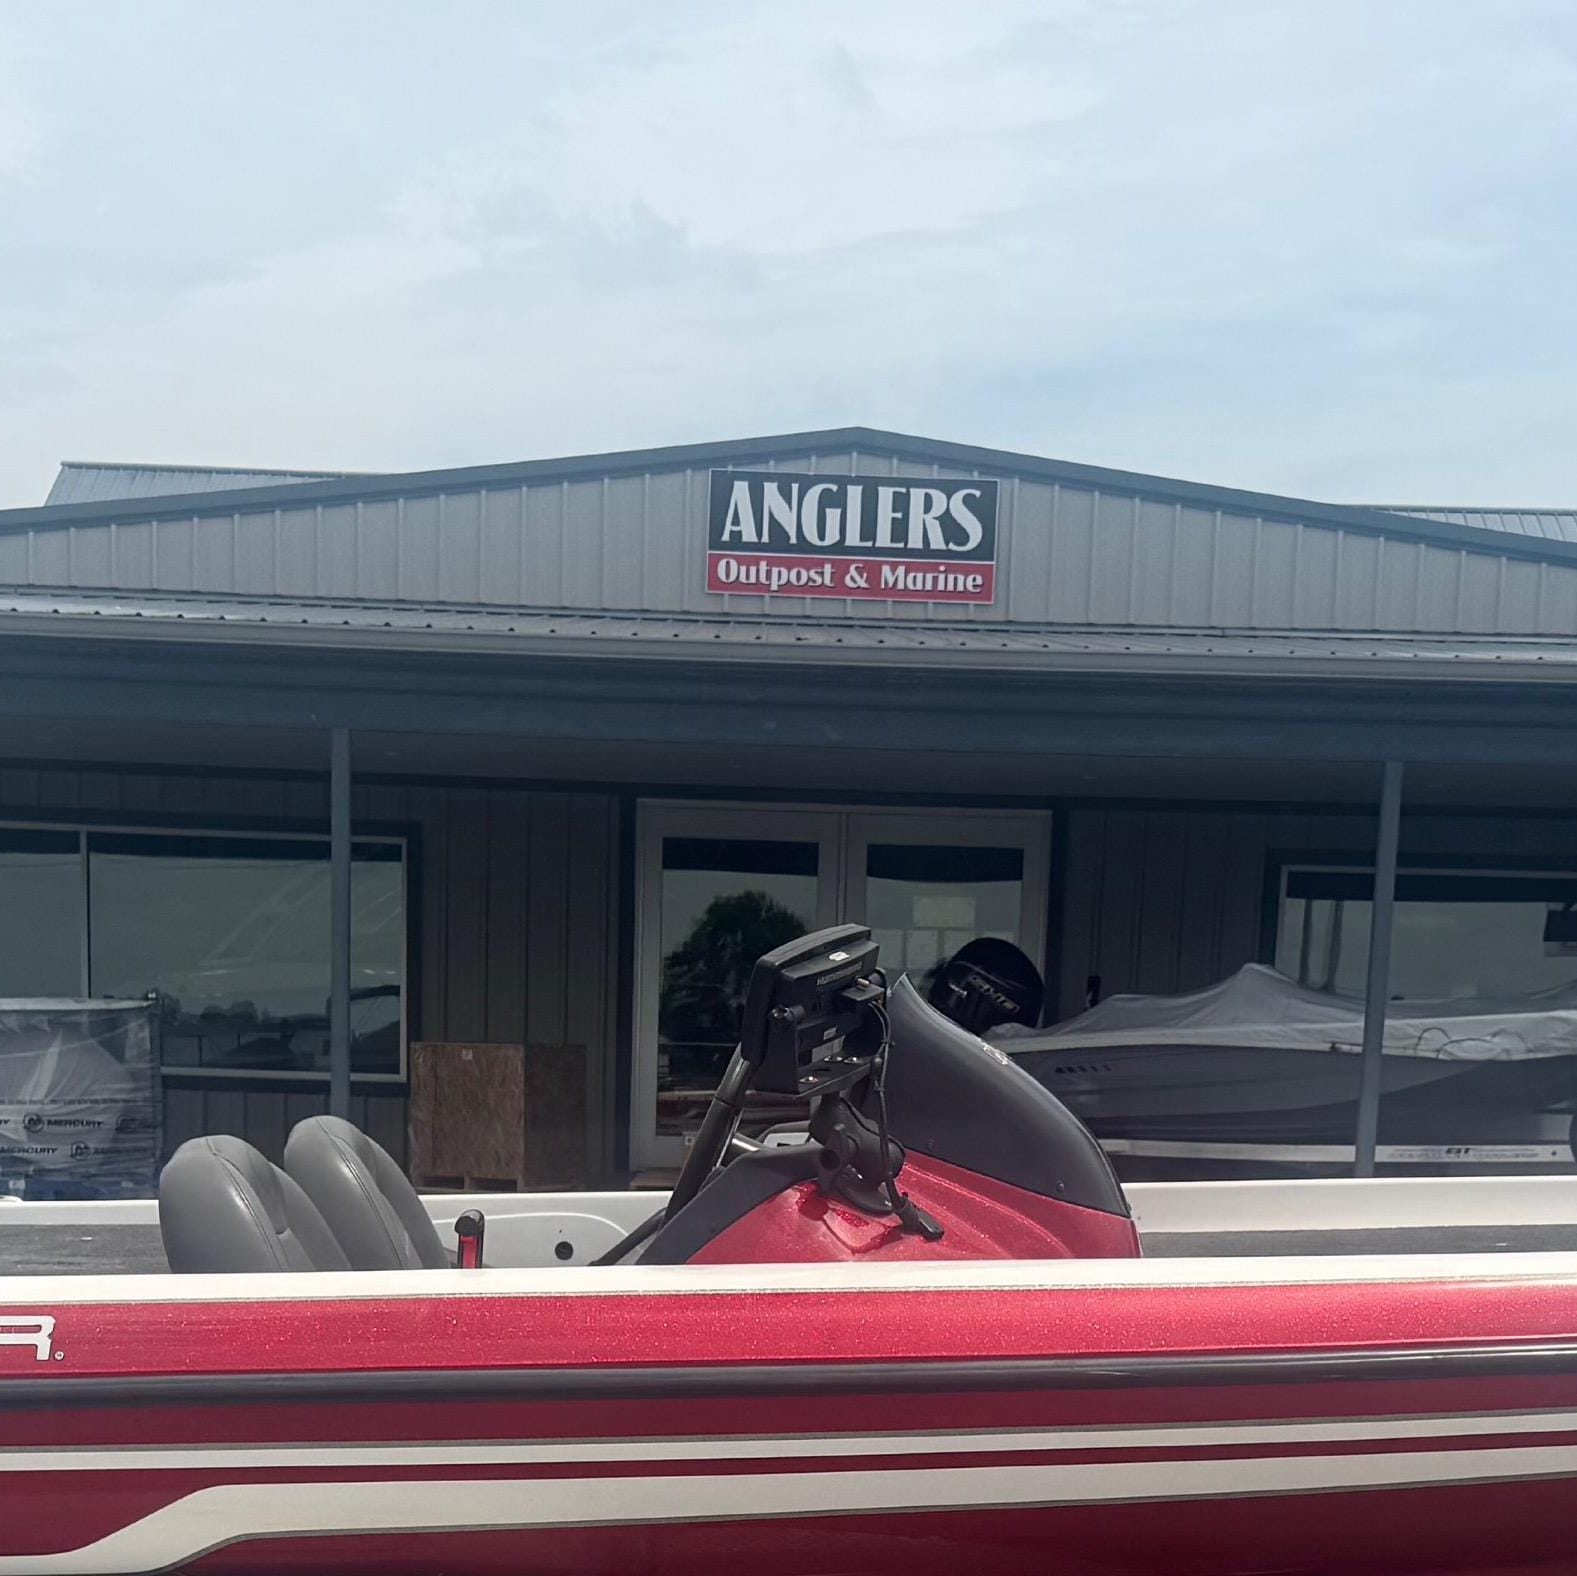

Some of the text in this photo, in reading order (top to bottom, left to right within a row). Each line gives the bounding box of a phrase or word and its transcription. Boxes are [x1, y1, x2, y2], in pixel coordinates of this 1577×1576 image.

[720, 480, 984, 553] ANGLERS
[716, 557, 984, 594] Outpost & Marine
[46, 1118, 105, 1128] MERCURY
